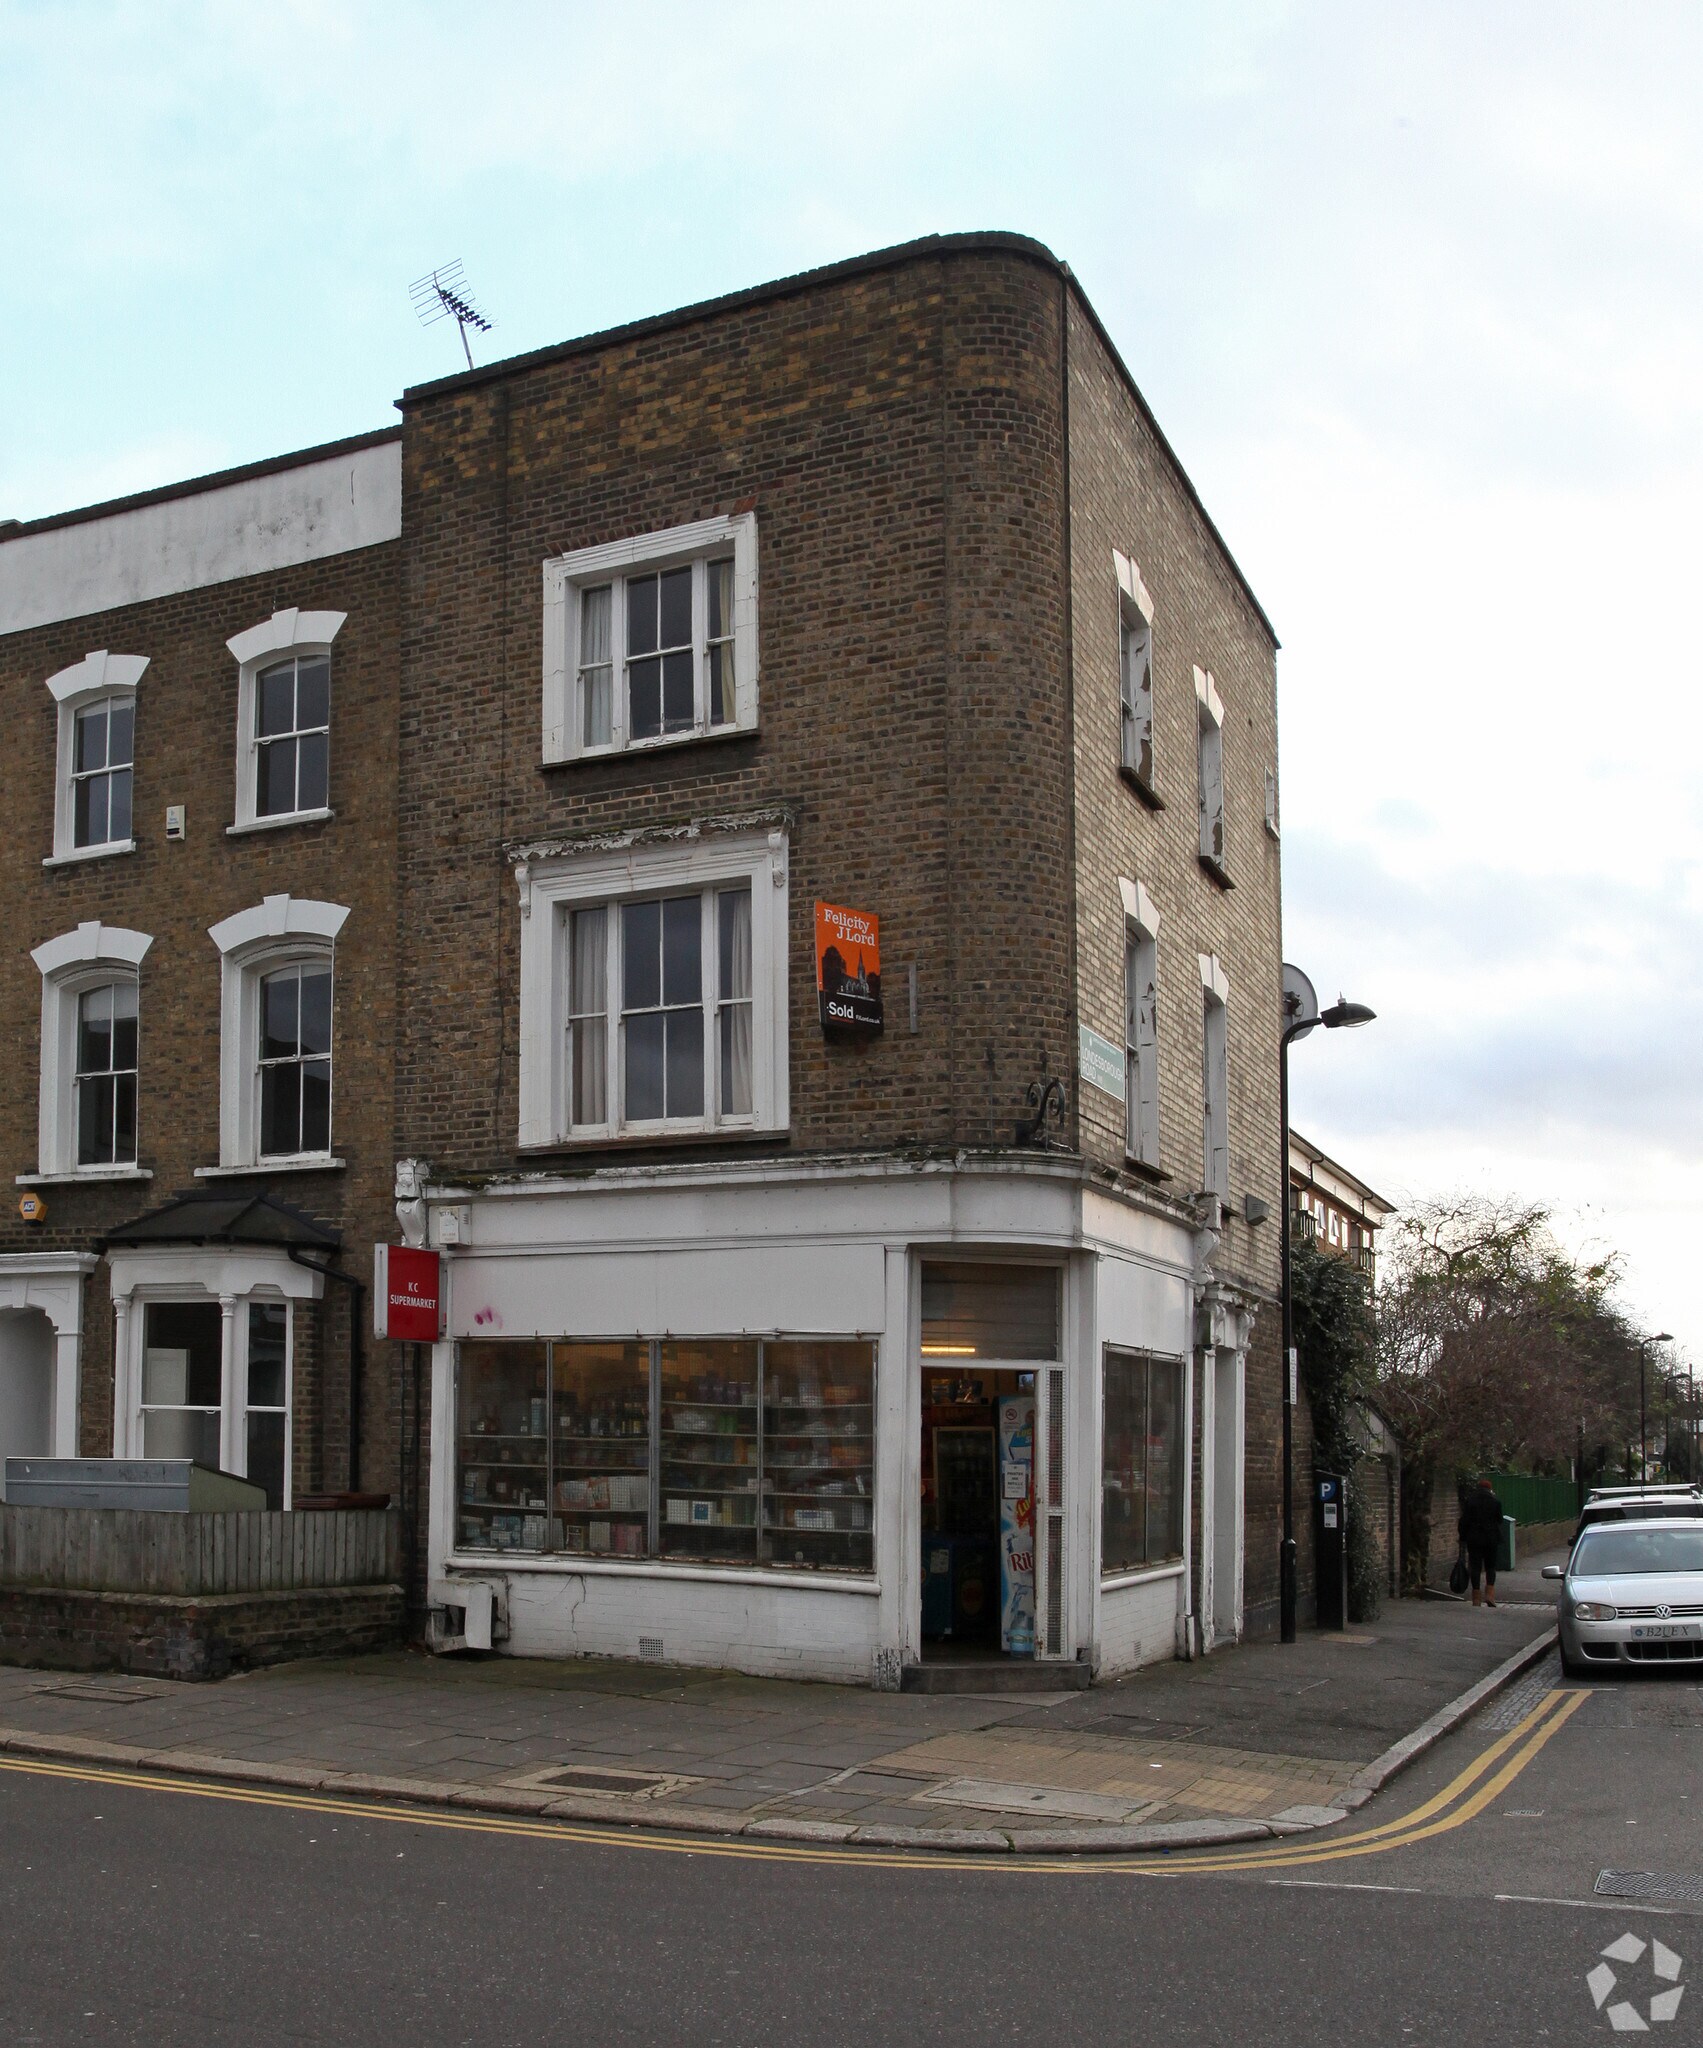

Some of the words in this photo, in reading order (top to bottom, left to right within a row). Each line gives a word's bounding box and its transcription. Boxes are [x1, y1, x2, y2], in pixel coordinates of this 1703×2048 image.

[824, 909, 870, 934] Felicity
[846, 928, 876, 946] Lord
[828, 1001, 854, 1019] Sold
[1081, 1046, 1123, 1082] LONDESBOROUGH
[1082, 1060, 1097, 1080] ROAD
[390, 1294, 436, 1309] SUPERMARKET
[1321, 1483, 1331, 1497] P
